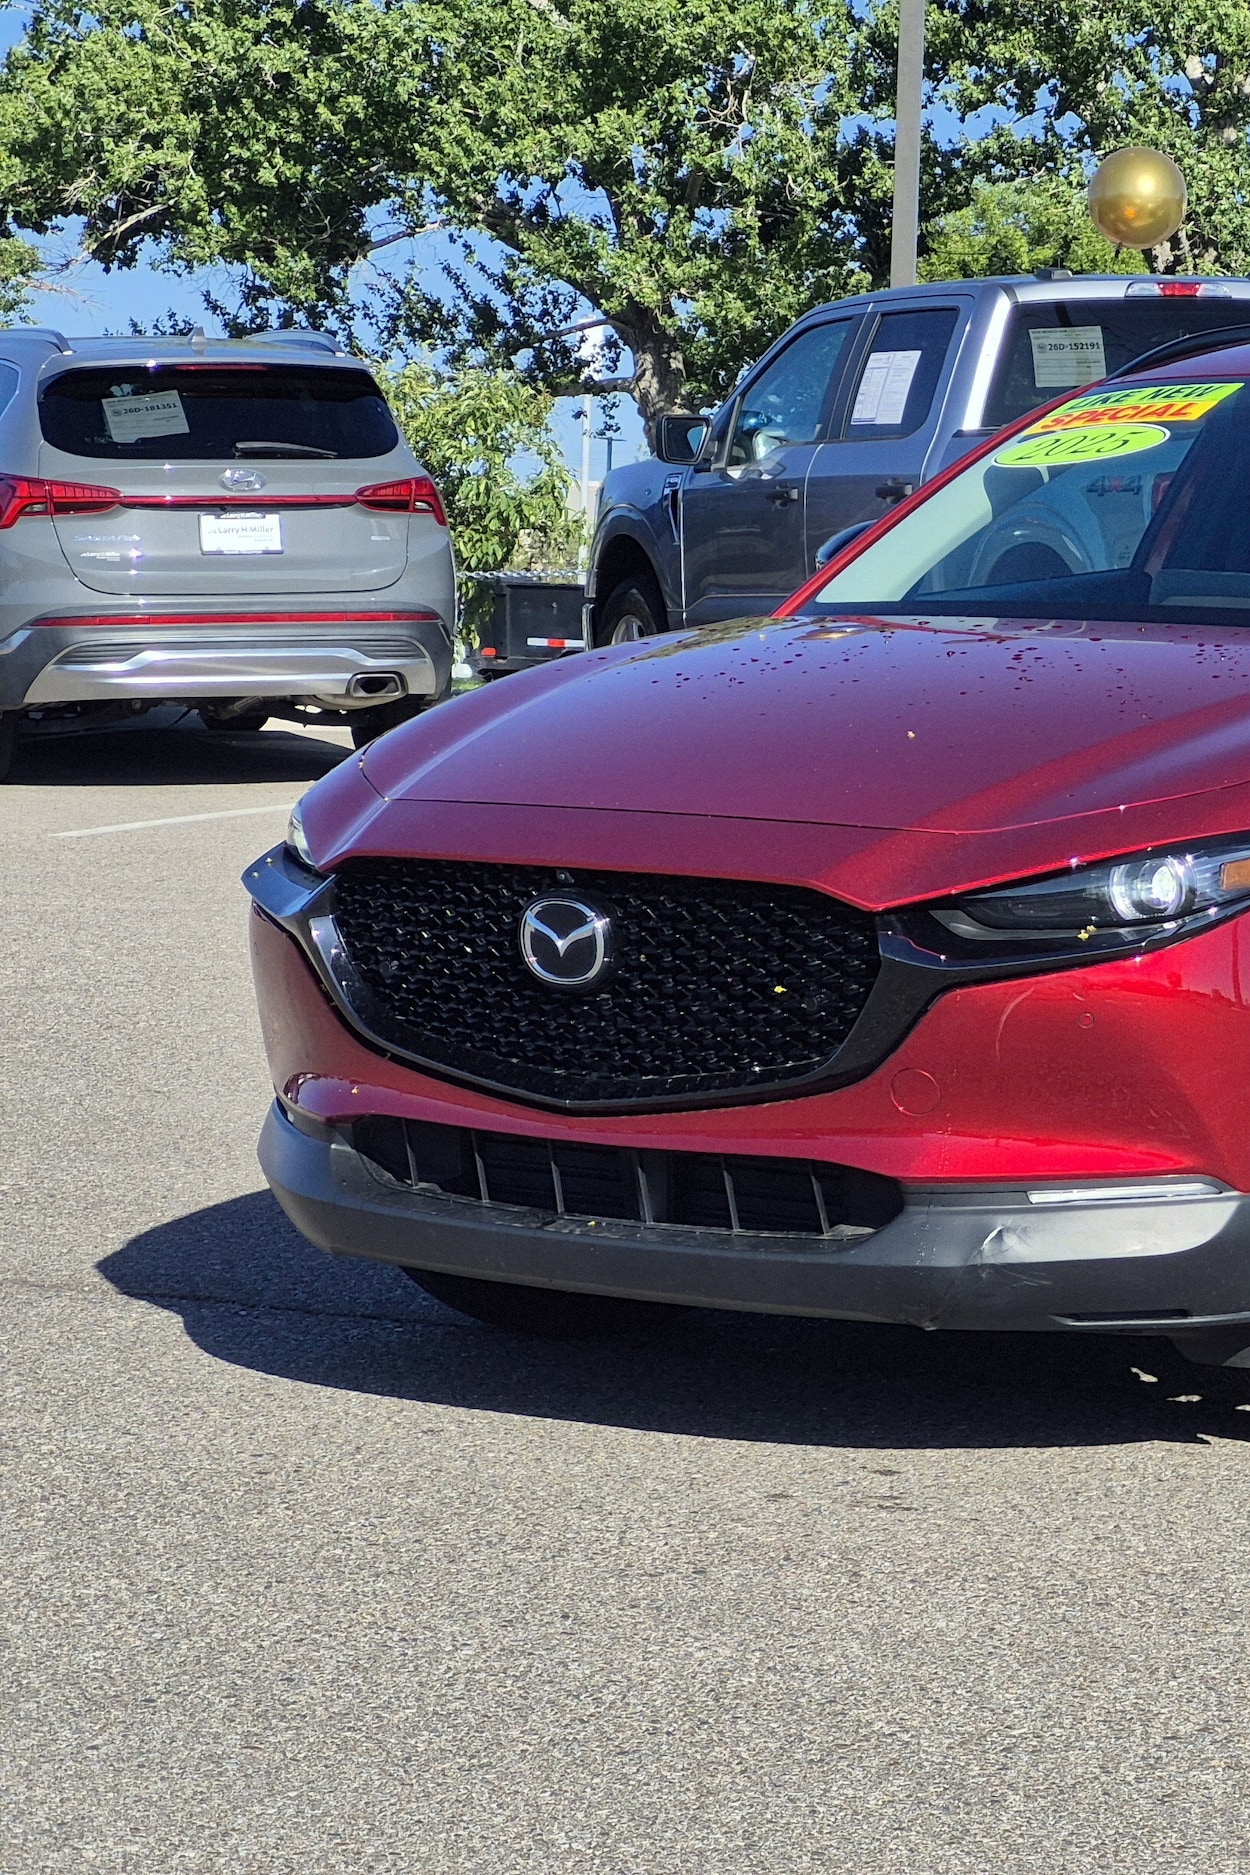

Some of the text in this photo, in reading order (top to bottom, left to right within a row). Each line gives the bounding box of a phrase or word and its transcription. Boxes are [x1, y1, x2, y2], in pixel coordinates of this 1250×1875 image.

[1048, 342, 1101, 351] 26D-152191
[1067, 385, 1226, 411] LIKE NEW
[122, 402, 178, 415] 26D-181351
[1041, 402, 1197, 430] SPECIAL
[1012, 431, 1147, 461] 2025
[218, 526, 240, 535] Larry
[249, 525, 274, 533] Miller
